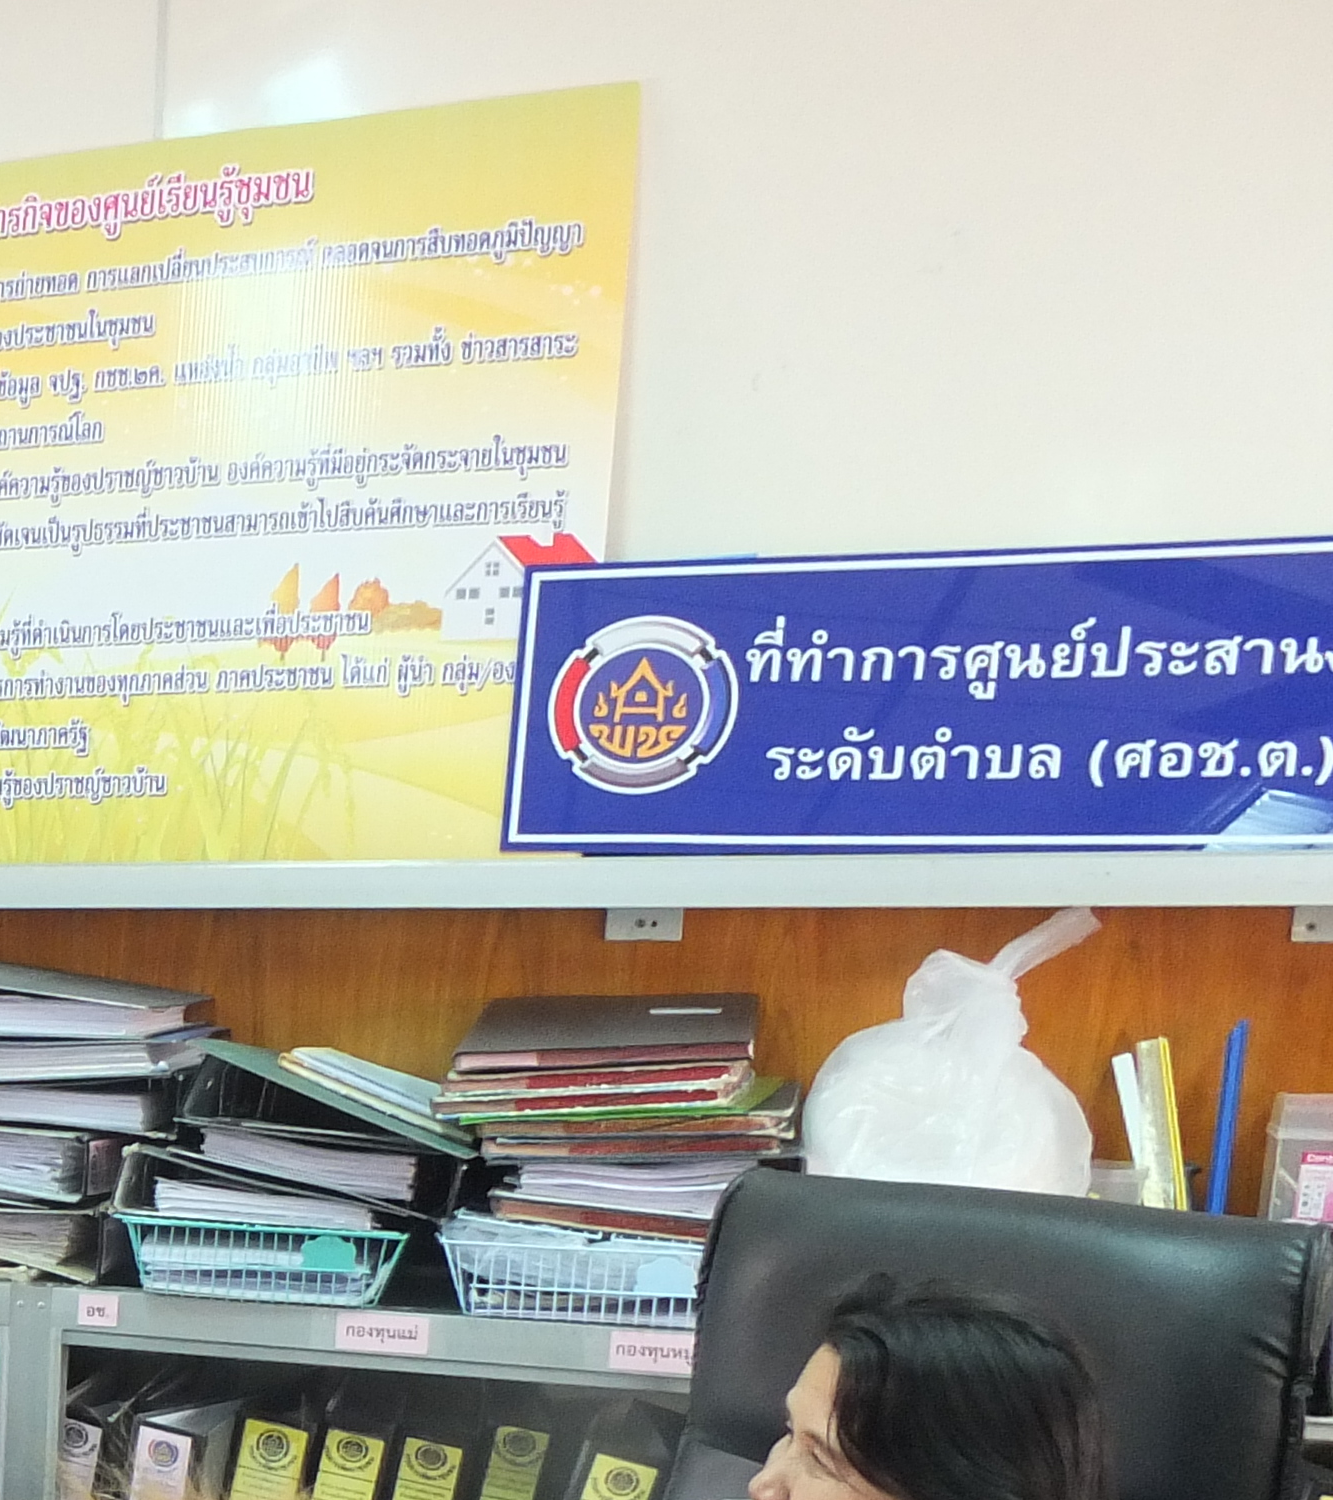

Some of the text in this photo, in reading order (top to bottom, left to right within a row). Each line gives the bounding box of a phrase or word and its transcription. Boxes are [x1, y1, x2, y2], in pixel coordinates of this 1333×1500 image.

[391, 326, 452, 368] รวมทั้ง
[460, 332, 579, 360] ข่าวสารสาระ
[216, 664, 333, 694] ภาคประชาชน
[340, 653, 388, 686] ได้แก่
[397, 656, 434, 696] ผู้นำ
[764, 727, 1333, 789] ระดับตำบล (ศอช.ต.)
[345, 1320, 419, 1344] กองทุนแม่
